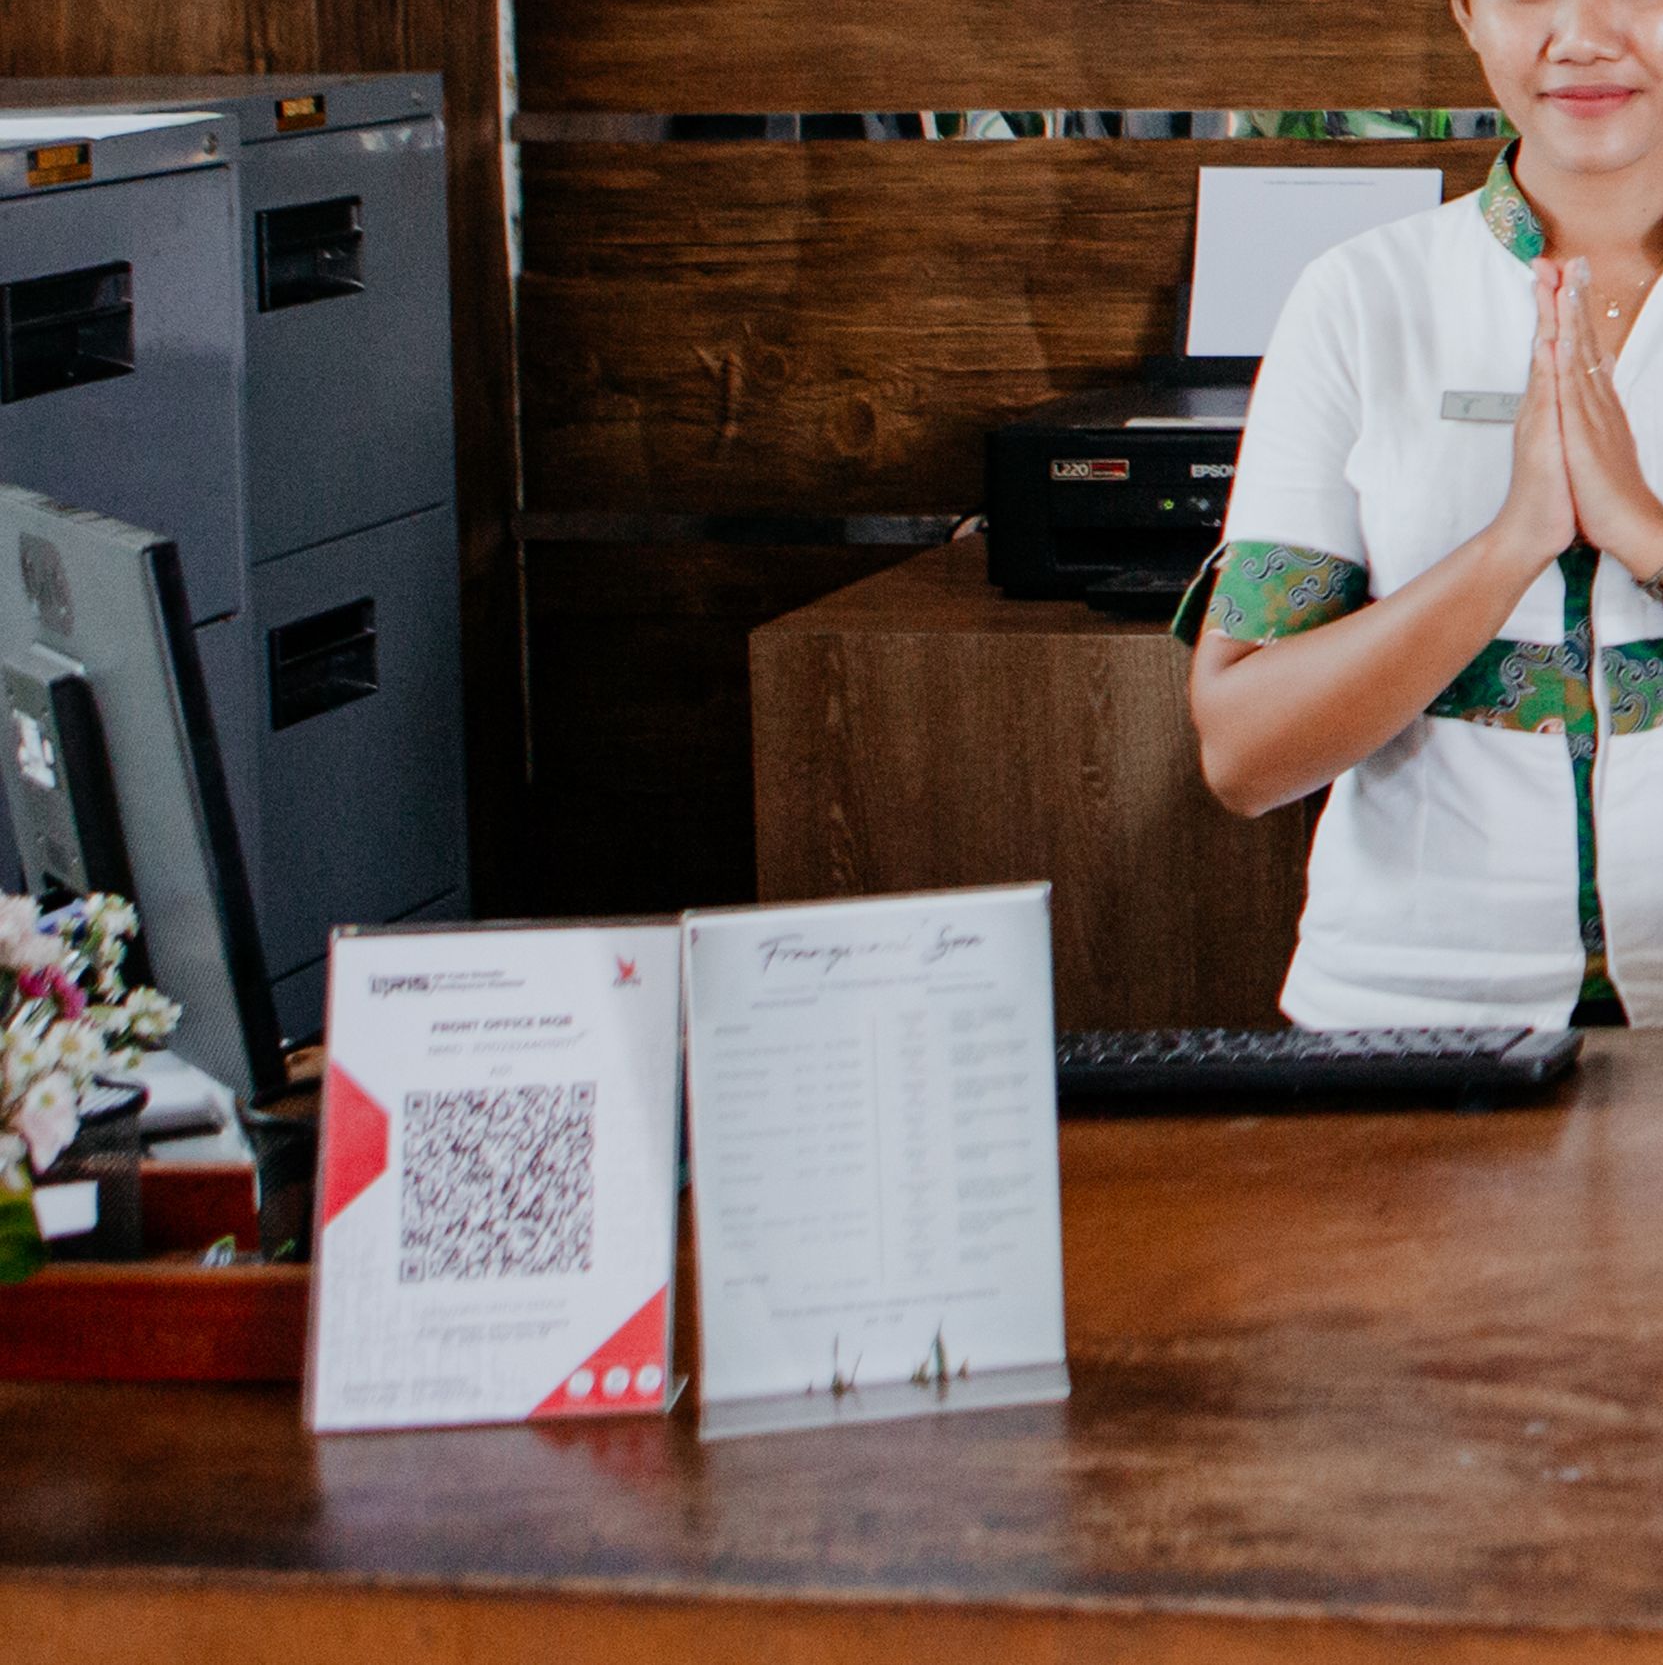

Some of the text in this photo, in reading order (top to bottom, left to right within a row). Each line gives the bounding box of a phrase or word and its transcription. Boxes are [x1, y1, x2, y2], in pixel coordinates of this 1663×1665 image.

[1054, 463, 1089, 477] L220
[431, 1020, 480, 1034] FRONT
[483, 1016, 535, 1032] OFFICE
